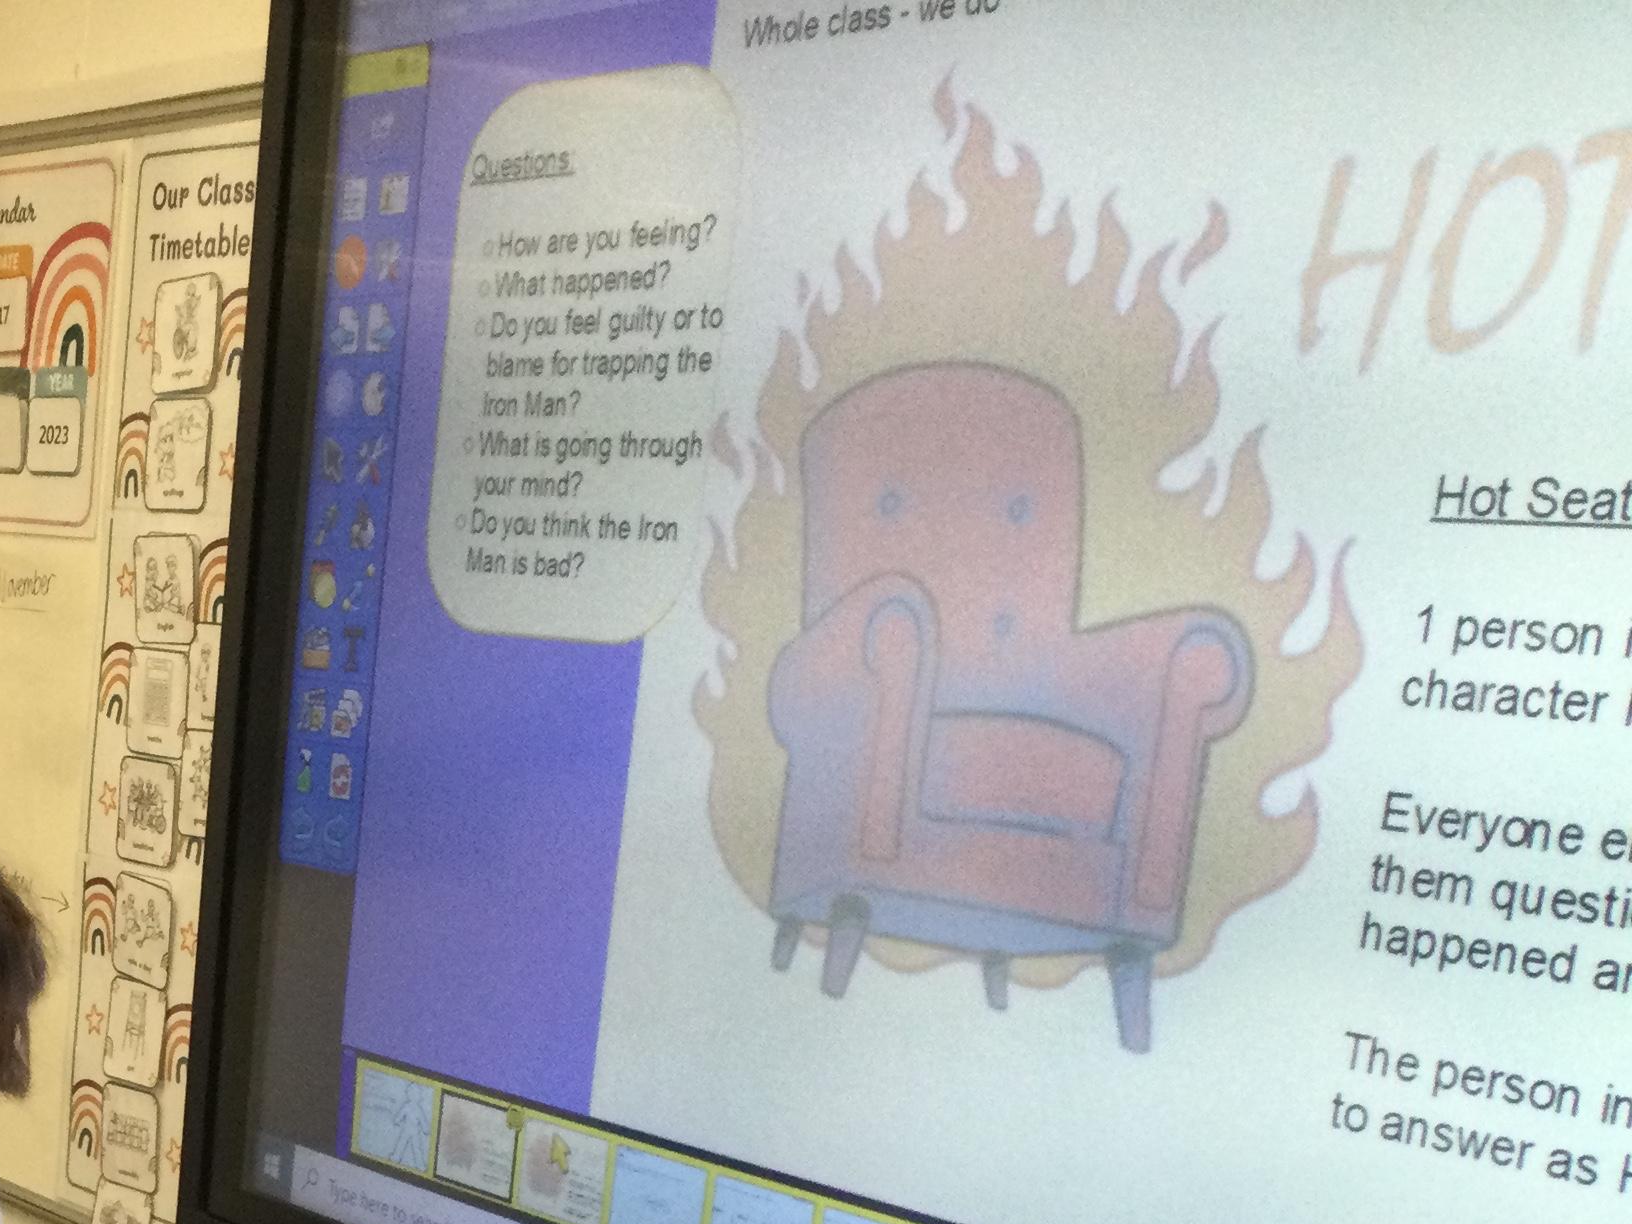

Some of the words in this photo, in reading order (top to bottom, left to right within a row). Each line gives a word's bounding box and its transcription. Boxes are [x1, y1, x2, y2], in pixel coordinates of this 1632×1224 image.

[744, 12, 819, 48] Whole
[828, 3, 892, 37] class
[153, 182, 189, 211] Our
[197, 172, 255, 207] Class
[149, 222, 251, 262] Timetable
[497, 231, 539, 258] How
[547, 233, 578, 254] are
[585, 229, 620, 258] you
[630, 213, 718, 252] feeling?
[1298, 130, 1632, 376] HOT
[495, 271, 546, 298] What
[553, 260, 671, 300] happened?
[490, 312, 518, 339] Do
[523, 316, 558, 344] you
[565, 307, 601, 336] feel
[608, 304, 667, 341] guilty
[673, 308, 696, 331] or
[700, 303, 724, 330] to
[49, 373, 74, 392] YEAR
[486, 350, 544, 378] blame
[552, 349, 578, 377] for
[582, 350, 669, 382] trapping
[678, 343, 713, 373] the
[481, 391, 518, 417] Iron
[524, 389, 582, 417] Man?
[39, 425, 70, 445] 2023
[479, 430, 529, 458] What
[536, 431, 550, 456] is
[555, 431, 612, 465] going
[620, 430, 704, 467] through
[473, 474, 515, 502] your
[521, 470, 584, 498] mind?
[1433, 475, 1512, 519] Hot
[470, 507, 497, 535] Do
[503, 514, 536, 541] you
[542, 510, 591, 539] think
[598, 512, 631, 540] the
[638, 512, 678, 542] Iron
[466, 547, 506, 575] Man
[512, 549, 528, 575] is
[533, 550, 585, 578] bad?
[1418, 604, 1435, 643] 1
[1451, 615, 1604, 657] person
[1401, 668, 1610, 723] character
[1380, 790, 1584, 856] Everyone
[1370, 854, 1474, 906] them
[1491, 879, 1632, 930] questi
[1360, 911, 1578, 984] happened
[1345, 1030, 1420, 1082] The
[1431, 1058, 1581, 1118] person
[1332, 1091, 1369, 1135] to
[1381, 1111, 1535, 1171] answer
[1546, 1148, 1599, 1186] as
[329, 1178, 358, 1208] Type
[360, 1192, 390, 1219] here
[392, 1204, 407, 1224] to
